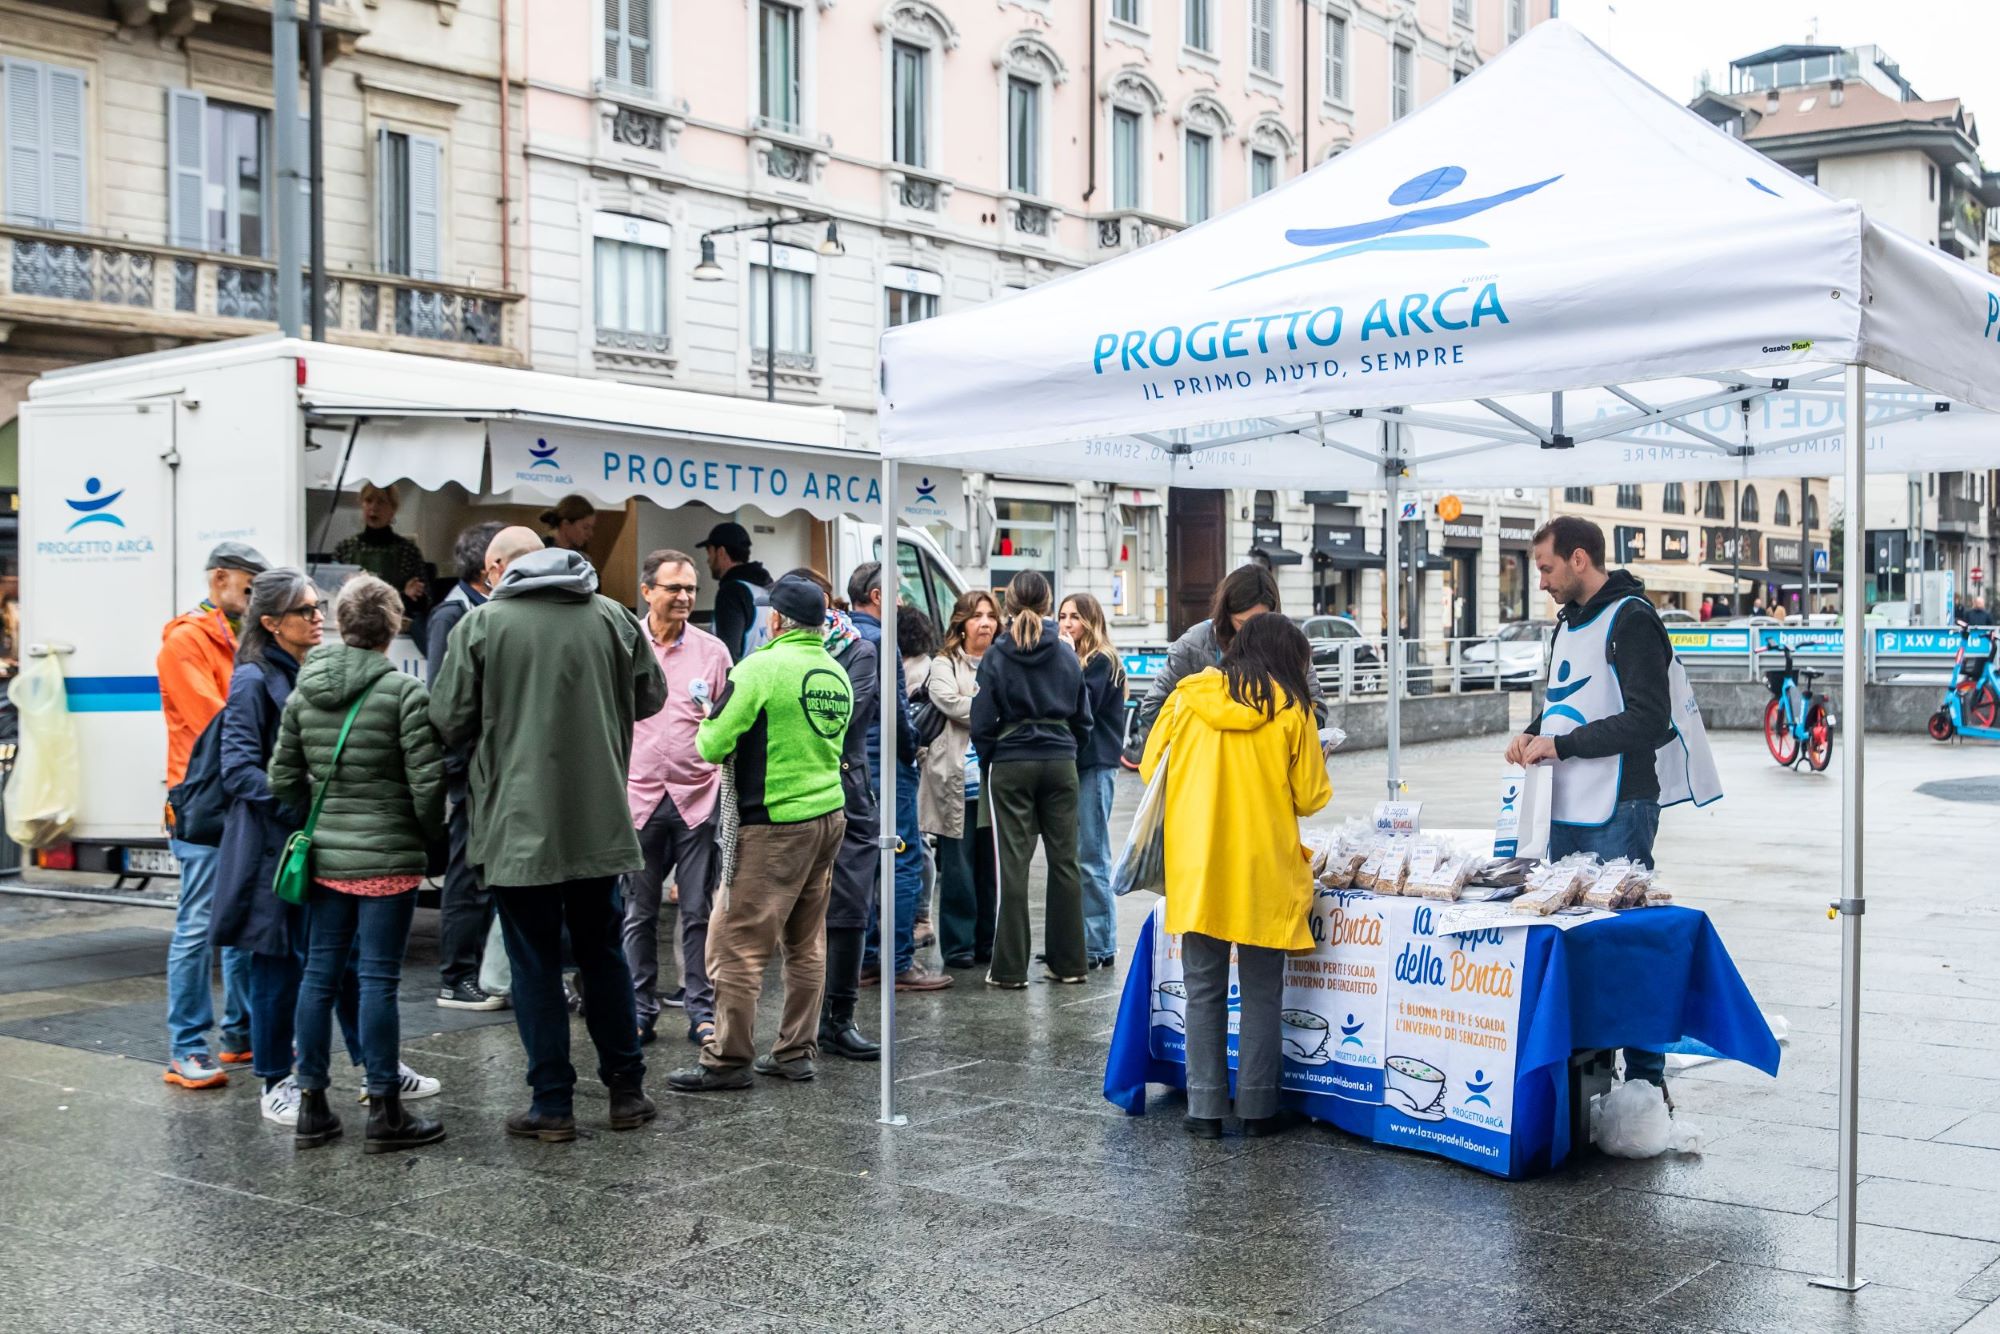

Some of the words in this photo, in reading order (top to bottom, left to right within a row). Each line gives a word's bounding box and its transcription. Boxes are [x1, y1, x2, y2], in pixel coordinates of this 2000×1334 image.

[1093, 305, 1344, 375] PROGETTO
[1360, 282, 1510, 342] ARCA
[1762, 345, 1791, 353] Gazebo
[1791, 341, 1811, 351] Flash
[1142, 383, 1164, 400] IL
[1175, 372, 1252, 398] PRIMO
[1265, 359, 1348, 385] AIUTO,
[1361, 345, 1465, 373] SEMPRE
[603, 451, 788, 496] PROGETTO
[803, 472, 882, 505] ARCA
[37, 541, 112, 555] PROGETTO
[117, 538, 154, 553] ARCA
[1904, 634, 1934, 647] XXV
[1938, 634, 1981, 650] aprle
[1329, 907, 1384, 947] Bontà
[1412, 905, 1435, 936] la
[1294, 959, 1321, 973] BUONA
[1323, 961, 1337, 975] PER
[1347, 965, 1376, 979] SCALDA
[1395, 942, 1446, 986] della
[1450, 950, 1516, 998] Bontà
[1407, 1002, 1438, 1020] BUONA
[1440, 1008, 1455, 1023] PER
[1457, 1011, 1466, 1026] TE
[1468, 1014, 1473, 1027] E
[1475, 1015, 1506, 1033] SCALDA
[1395, 1018, 1442, 1039] L'INVERNO
[1444, 1026, 1457, 1041] DEI
[1459, 1030, 1507, 1052] SENZATETTO
[1357, 1055, 1377, 1065] ARCA
[1452, 1106, 1484, 1123] PROGETTO
[1485, 1116, 1504, 1129] ARCA
[1390, 1123, 1500, 1158] www.lazuppadellabonta.it
